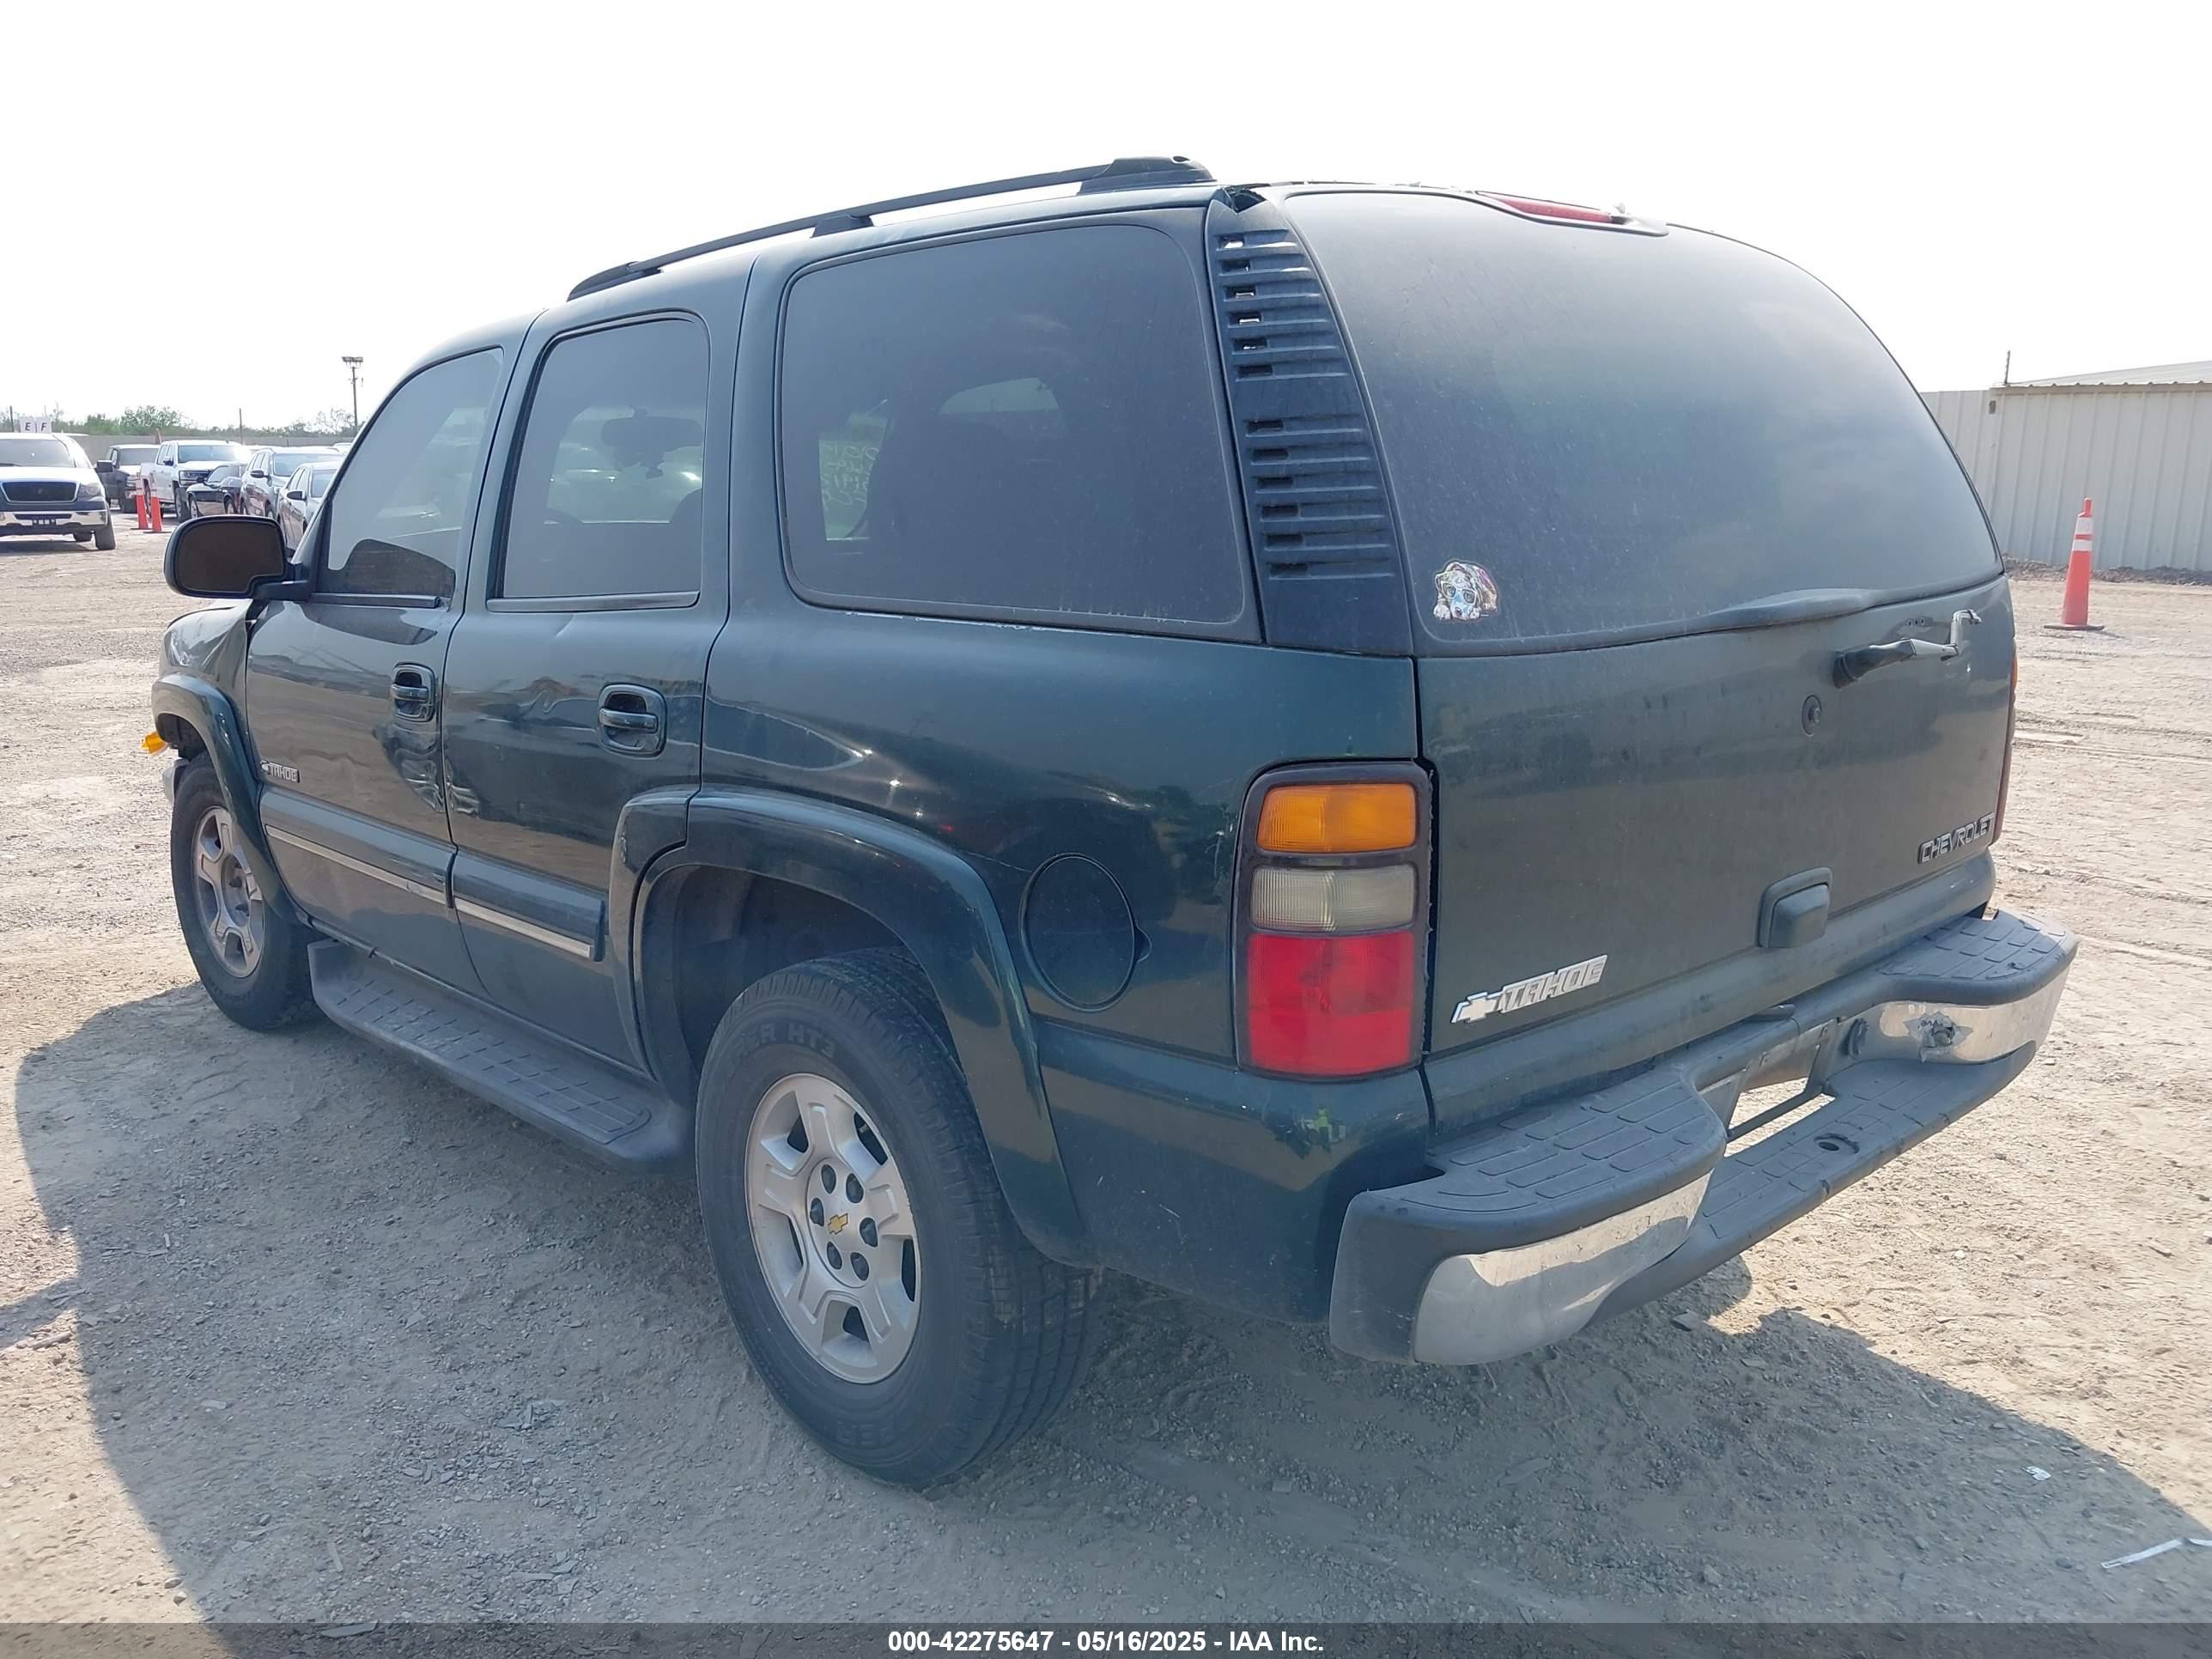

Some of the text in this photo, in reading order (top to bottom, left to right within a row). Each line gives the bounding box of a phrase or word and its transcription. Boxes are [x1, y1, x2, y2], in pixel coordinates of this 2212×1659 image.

[25, 422, 32, 431] E
[41, 422, 48, 431] F
[1917, 811, 1996, 864] CHEVROLET
[1501, 954, 1607, 1013] TAHOE
